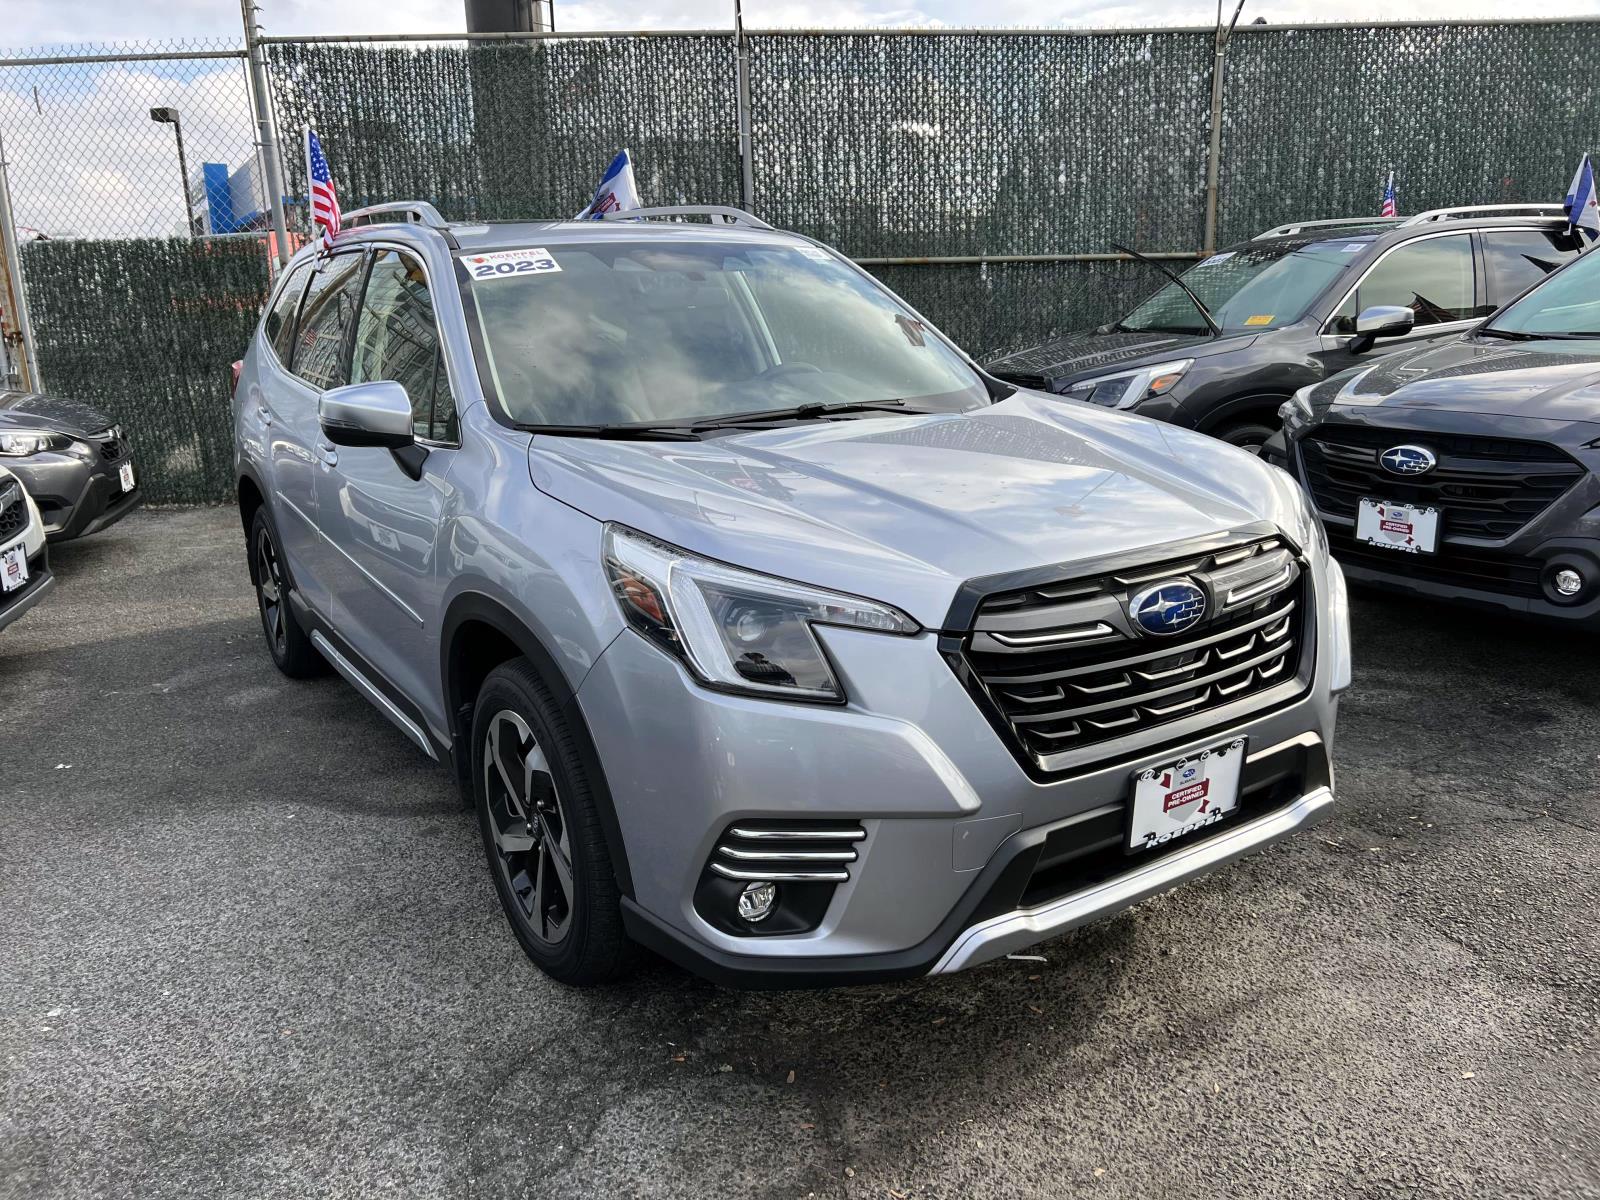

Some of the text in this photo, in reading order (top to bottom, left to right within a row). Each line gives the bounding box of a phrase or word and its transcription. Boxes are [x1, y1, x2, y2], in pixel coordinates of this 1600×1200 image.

[489, 250, 544, 260] KOEPPEL
[474, 259, 555, 277] 2023
[1368, 540, 1419, 554] KOEPPEL
[1167, 790, 1205, 808] PRE-OWNED
[1171, 784, 1202, 800] CERTIFIED
[1145, 813, 1223, 849] KOEPPEL
